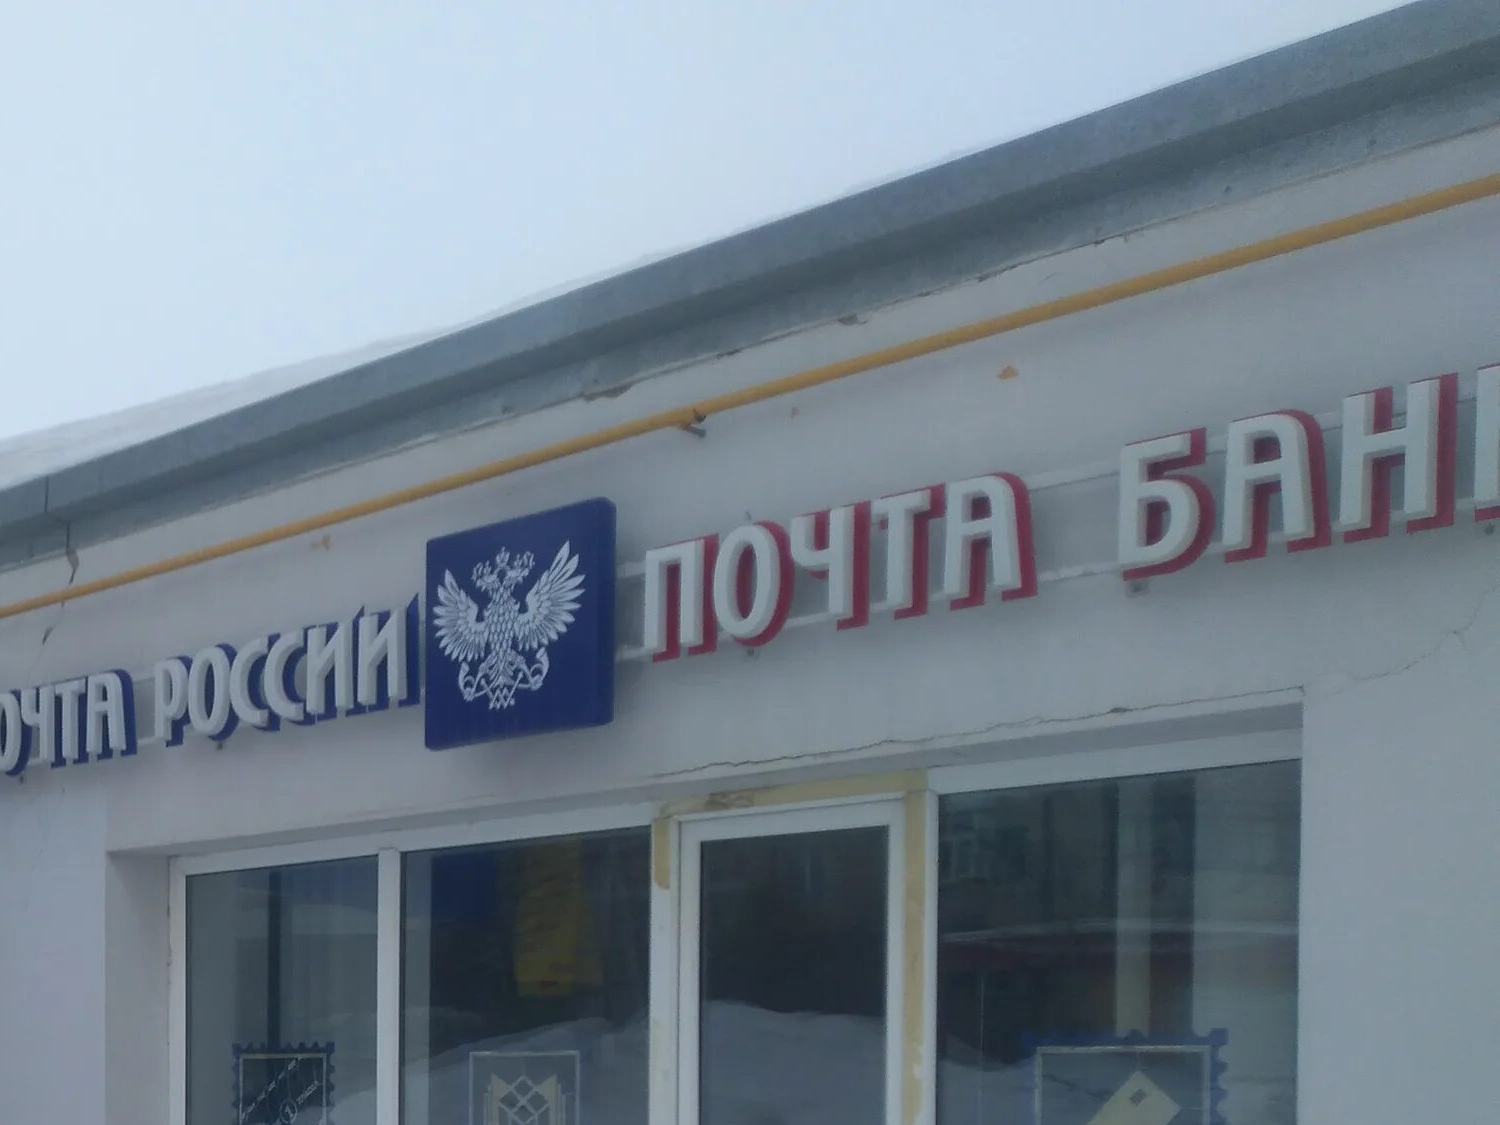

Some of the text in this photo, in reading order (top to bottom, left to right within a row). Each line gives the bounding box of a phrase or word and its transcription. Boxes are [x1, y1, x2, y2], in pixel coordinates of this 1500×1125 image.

[644, 362, 1500, 663] ПОЧТА БАН
[154, 592, 421, 748] РОССИИ
